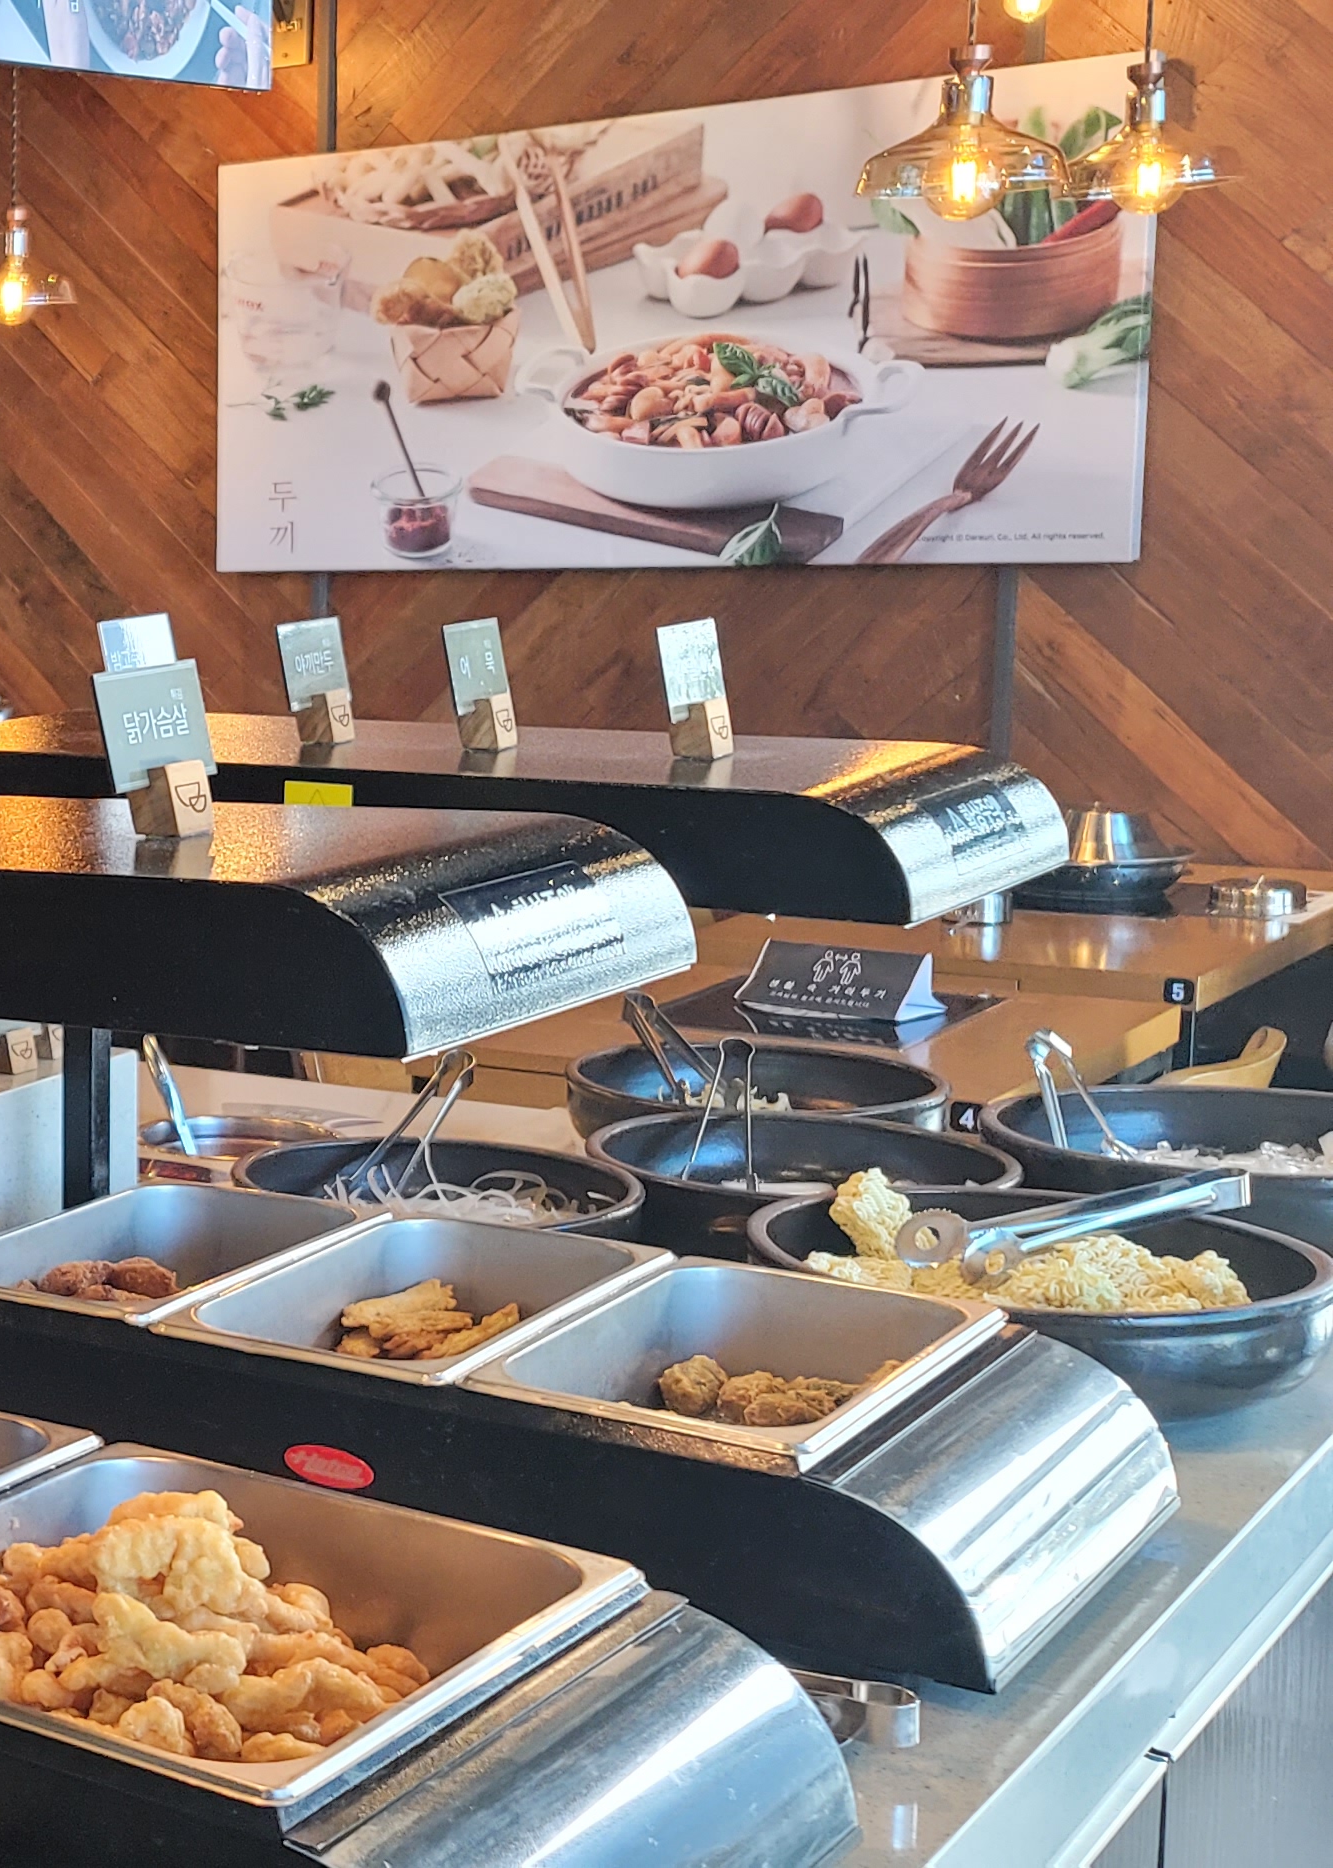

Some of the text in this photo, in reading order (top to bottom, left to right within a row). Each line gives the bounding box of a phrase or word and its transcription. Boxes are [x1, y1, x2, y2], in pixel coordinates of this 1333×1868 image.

[295, 650, 334, 676] 야끼만두
[122, 702, 190, 745] 닭가슴살
[1172, 983, 1185, 1001] 5
[959, 1107, 976, 1129] 4
